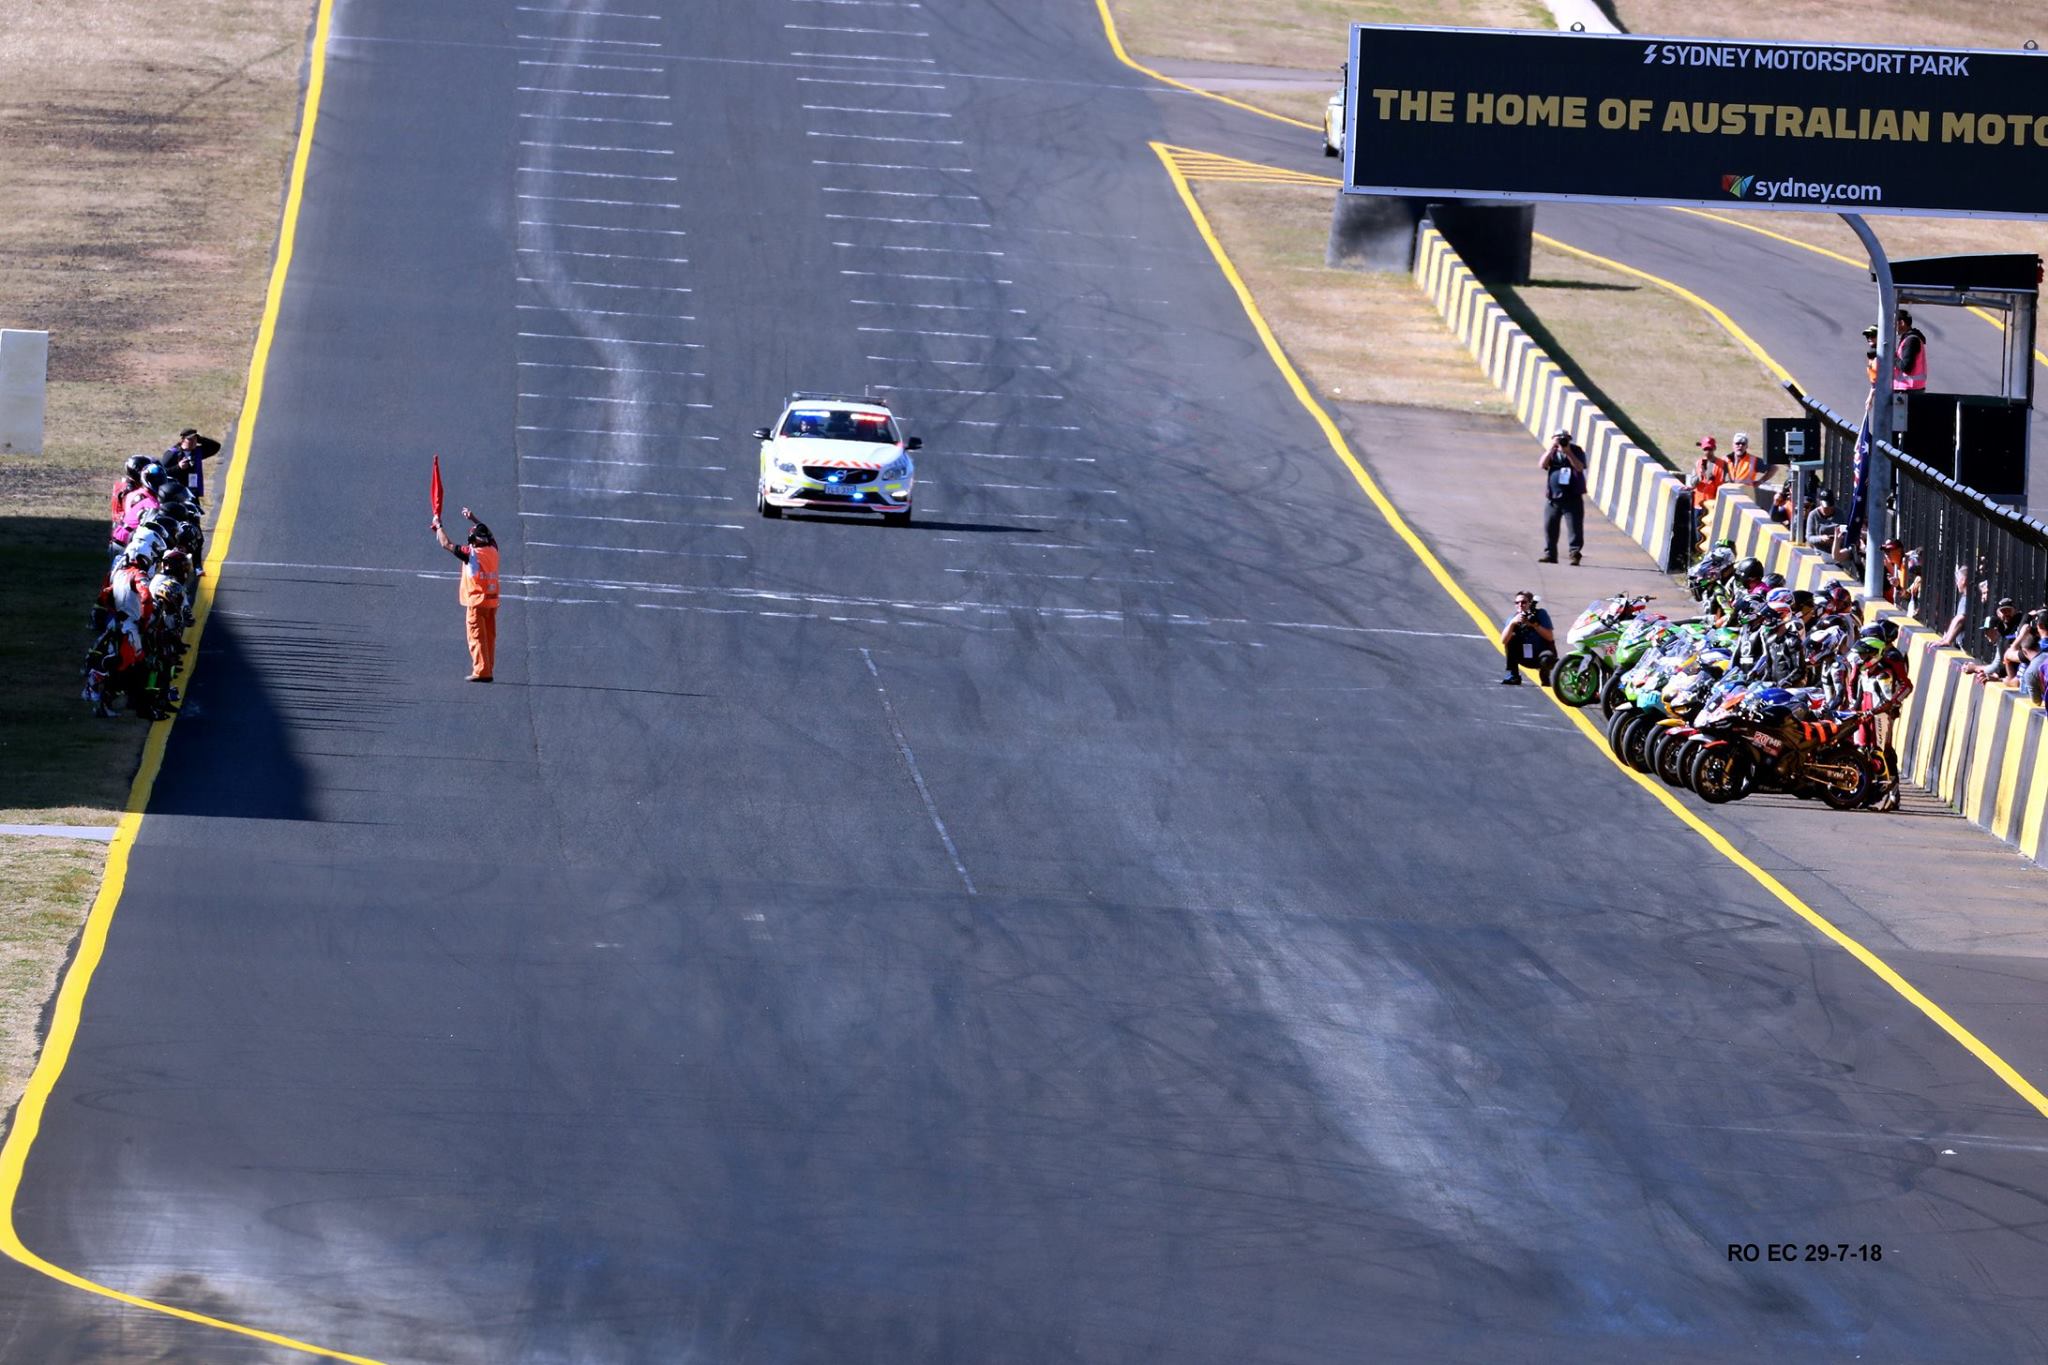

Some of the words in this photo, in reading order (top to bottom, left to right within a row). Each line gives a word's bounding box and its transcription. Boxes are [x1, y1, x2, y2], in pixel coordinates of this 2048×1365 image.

[1661, 44, 1752, 68] SYDNEY
[1754, 48, 1907, 74] MOTORSPORT
[1909, 54, 1970, 77] PARK
[1372, 88, 1455, 123] THE
[1466, 92, 1588, 128] HOME
[1598, 98, 1654, 131] OF
[1661, 101, 1930, 142] AUSTRALIAN
[1754, 177, 1882, 204] sydney.com
